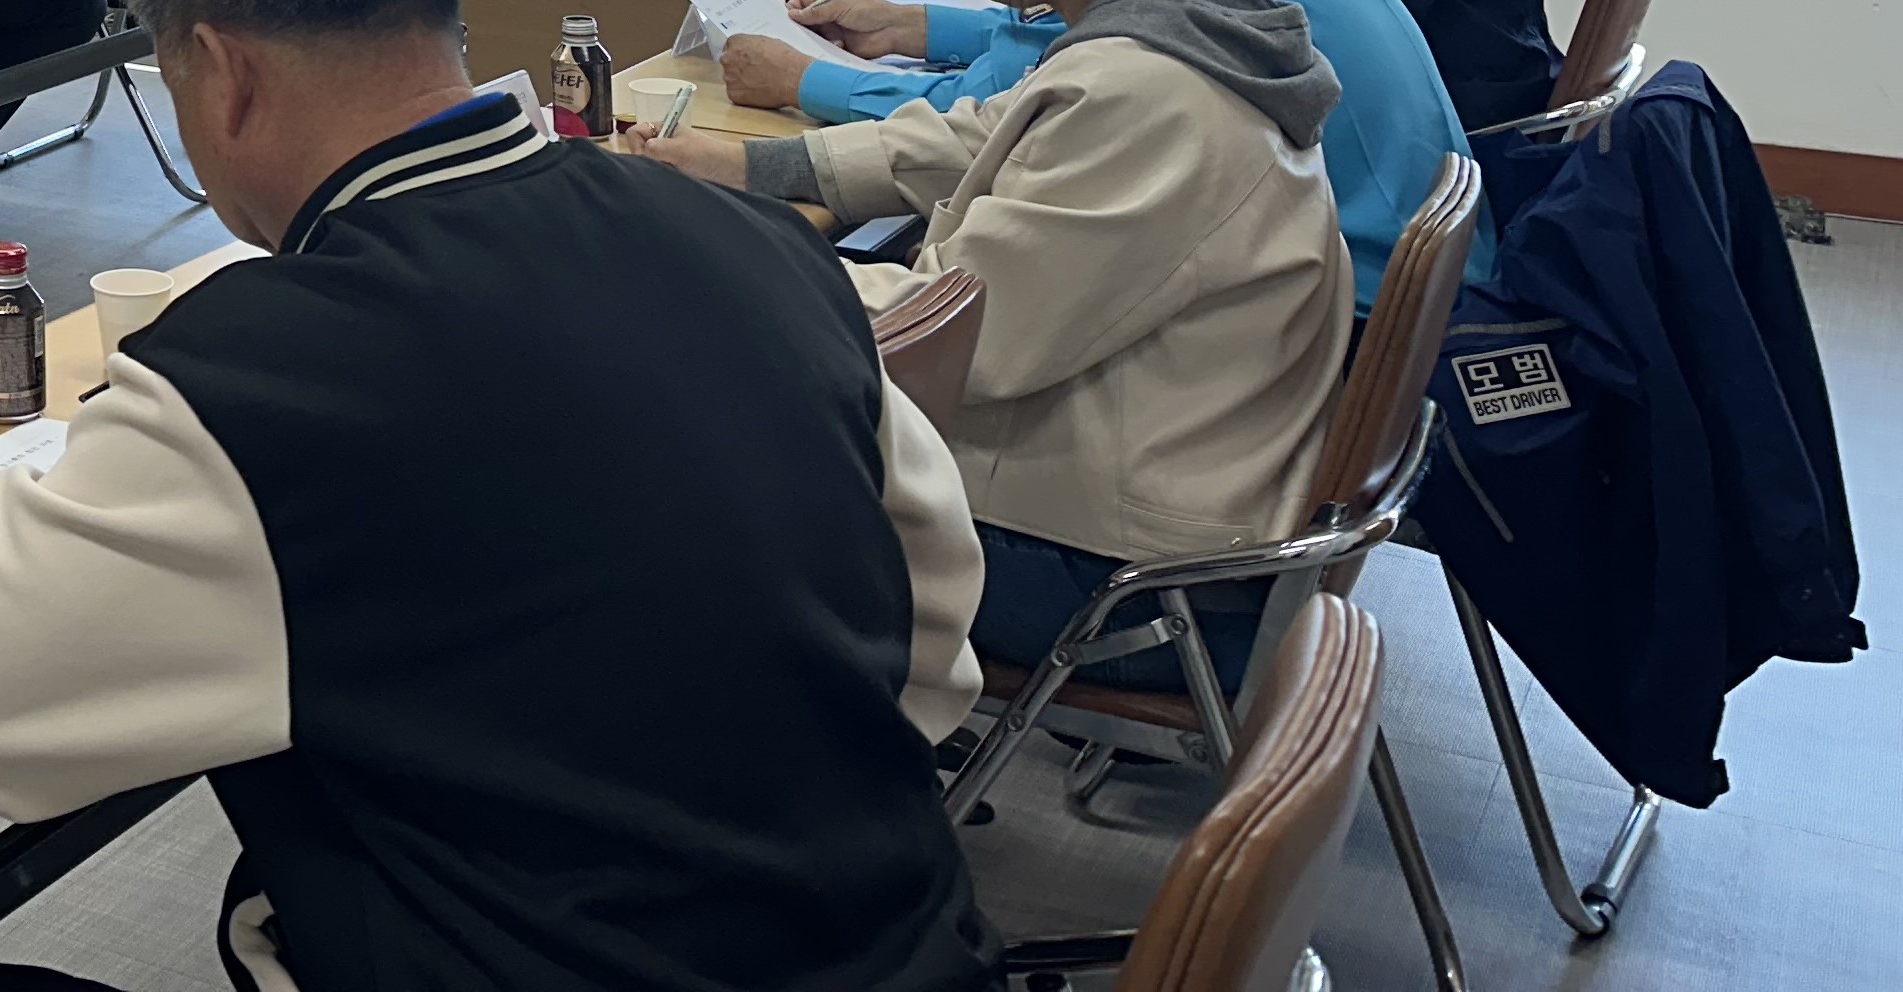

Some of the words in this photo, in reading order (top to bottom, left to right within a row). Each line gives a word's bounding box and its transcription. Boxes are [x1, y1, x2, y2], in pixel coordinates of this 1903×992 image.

[553, 72, 584, 89] 타타
[1473, 396, 1508, 417] BEST
[1510, 387, 1562, 412] DRIVER
